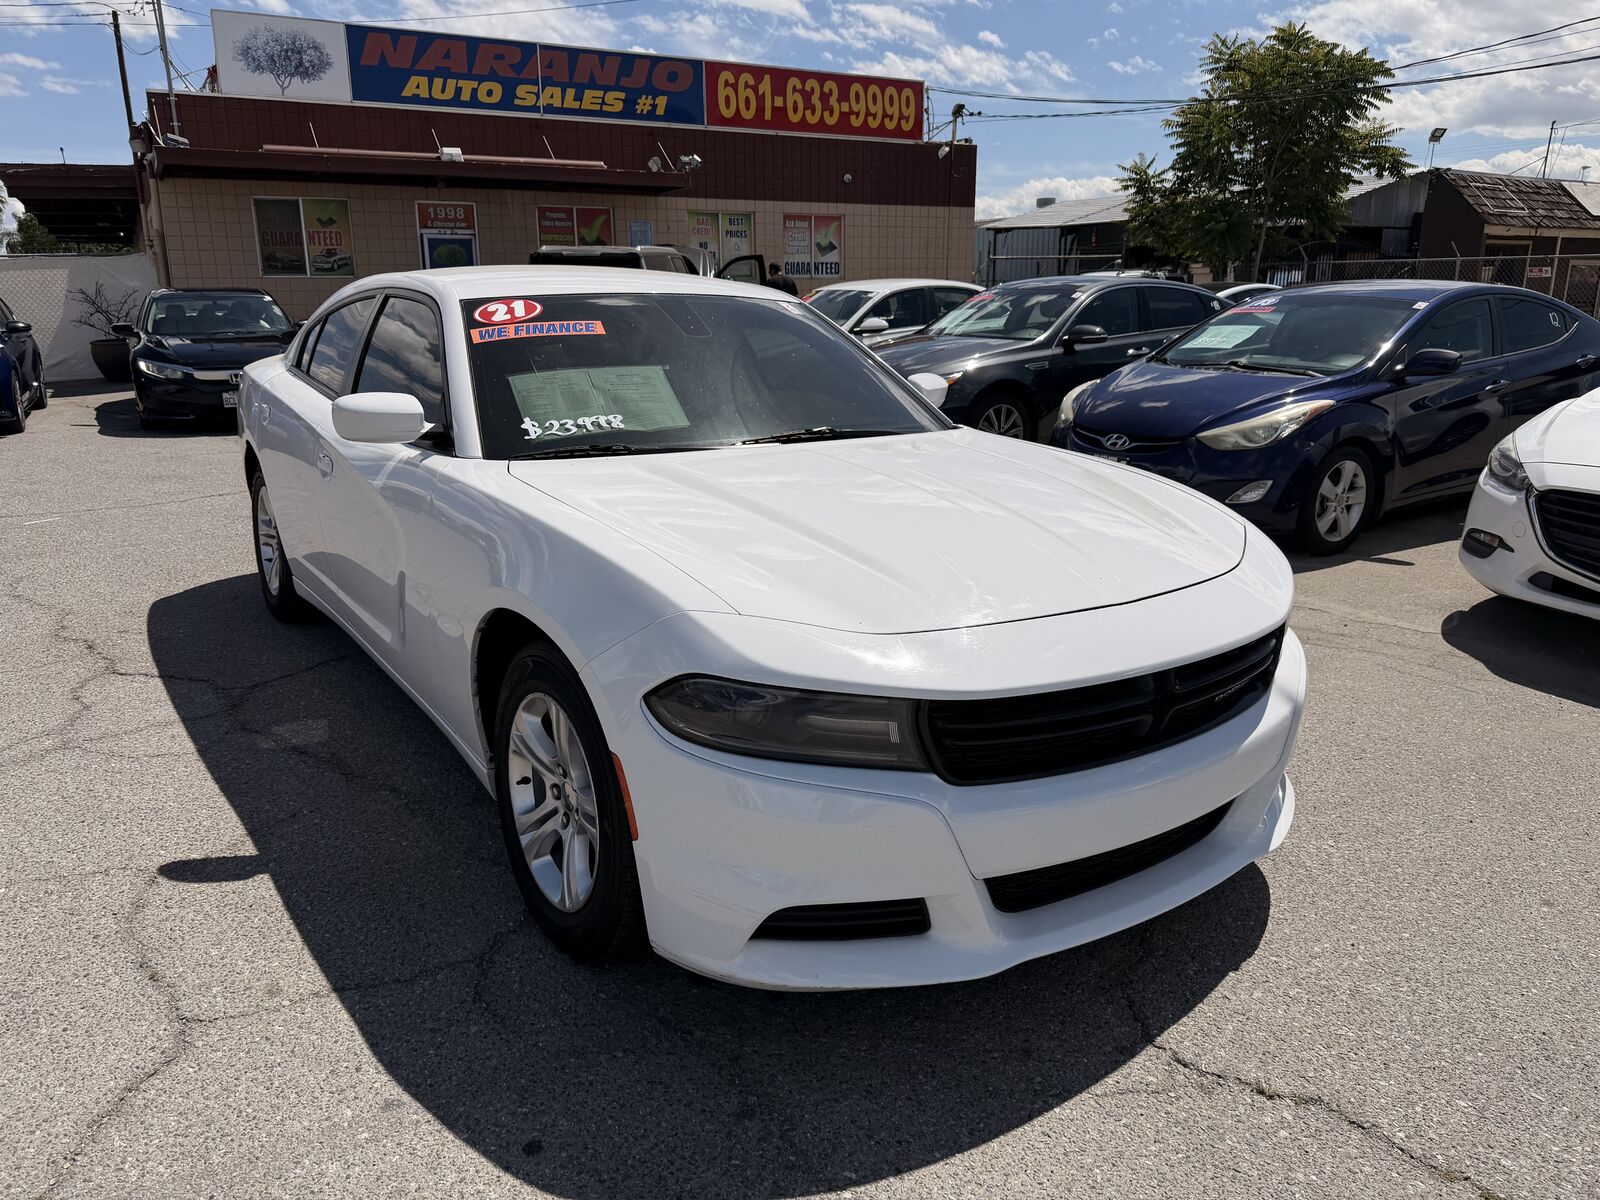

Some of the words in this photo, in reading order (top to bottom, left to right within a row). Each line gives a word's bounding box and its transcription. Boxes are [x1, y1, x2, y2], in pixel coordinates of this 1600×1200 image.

[360, 32, 693, 92] NARANJO
[401, 76, 503, 104] AUTO
[514, 84, 626, 112] SALES
[636, 95, 668, 115] #1
[717, 70, 915, 132] 661-633-9999
[427, 206, 465, 219] 1998
[728, 217, 743, 227] BEST
[262, 230, 343, 247] GUARANTEED
[725, 229, 748, 239] PRICES
[784, 261, 840, 276] GUARANTEED
[487, 300, 527, 322] 21
[478, 327, 510, 341] WE
[514, 322, 597, 336] FINANCE
